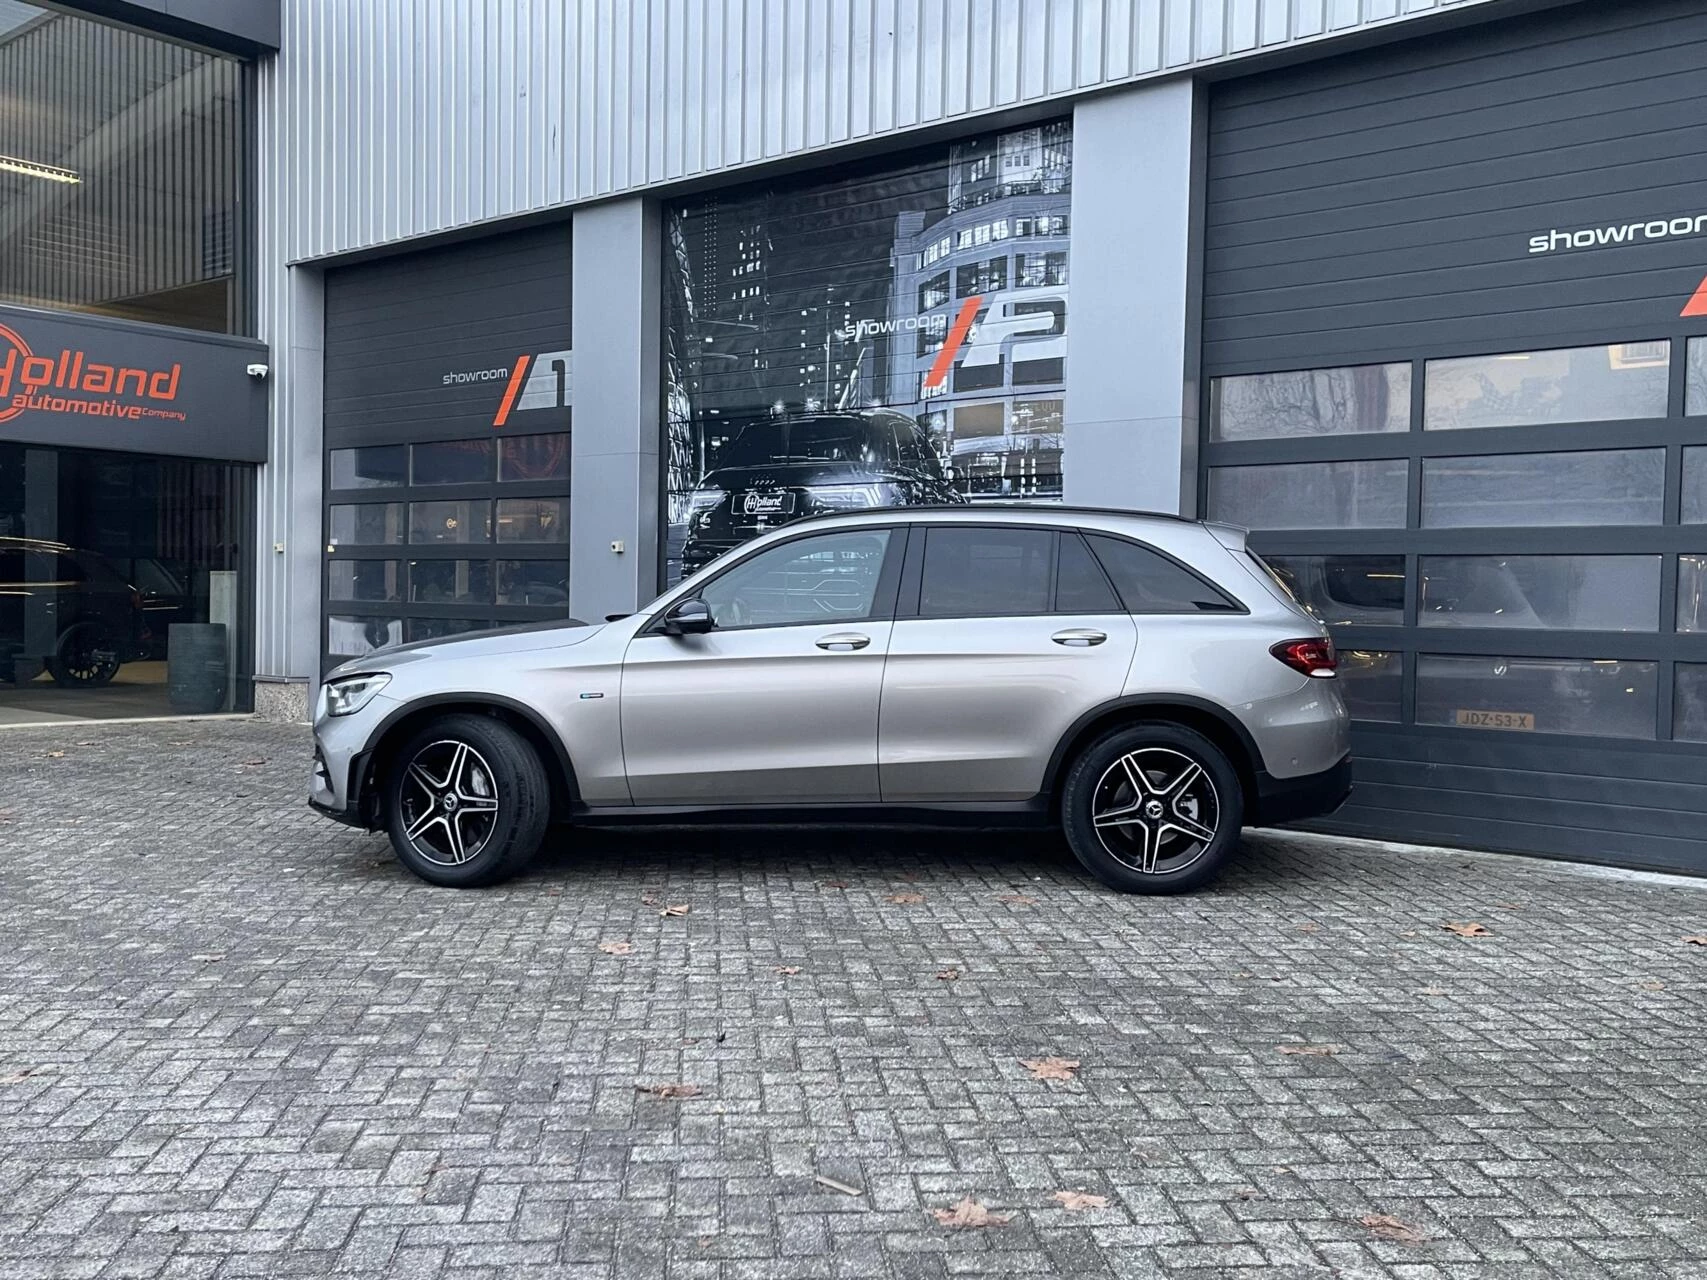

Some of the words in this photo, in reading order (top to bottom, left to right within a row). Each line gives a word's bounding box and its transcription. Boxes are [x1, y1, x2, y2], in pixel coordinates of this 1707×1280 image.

[844, 313, 947, 338] showroom
[442, 367, 508, 385] showroom
[12, 393, 142, 420] automotive
